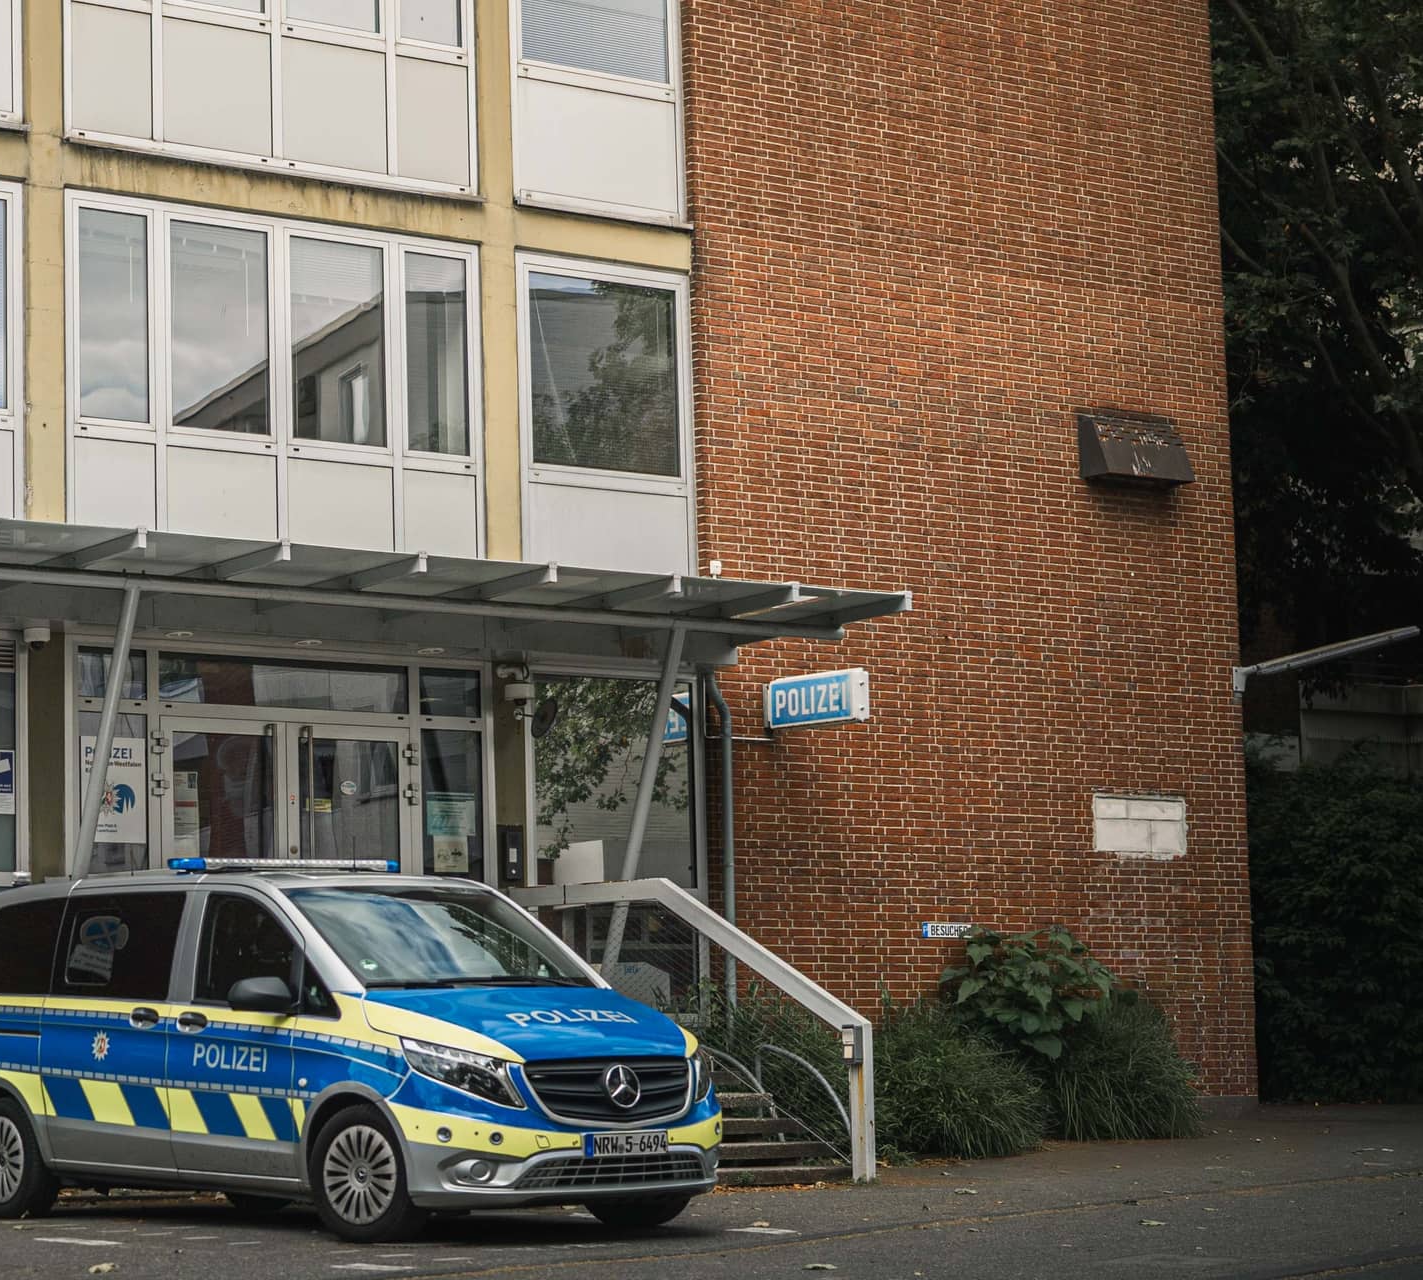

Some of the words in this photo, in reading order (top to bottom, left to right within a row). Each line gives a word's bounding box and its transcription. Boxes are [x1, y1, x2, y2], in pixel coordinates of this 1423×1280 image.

[775, 681, 847, 718] POLIZEI
[505, 1008, 639, 1027] POLIZEI
[192, 1043, 267, 1073] POLIZEI
[594, 1136, 618, 1154] NRW
